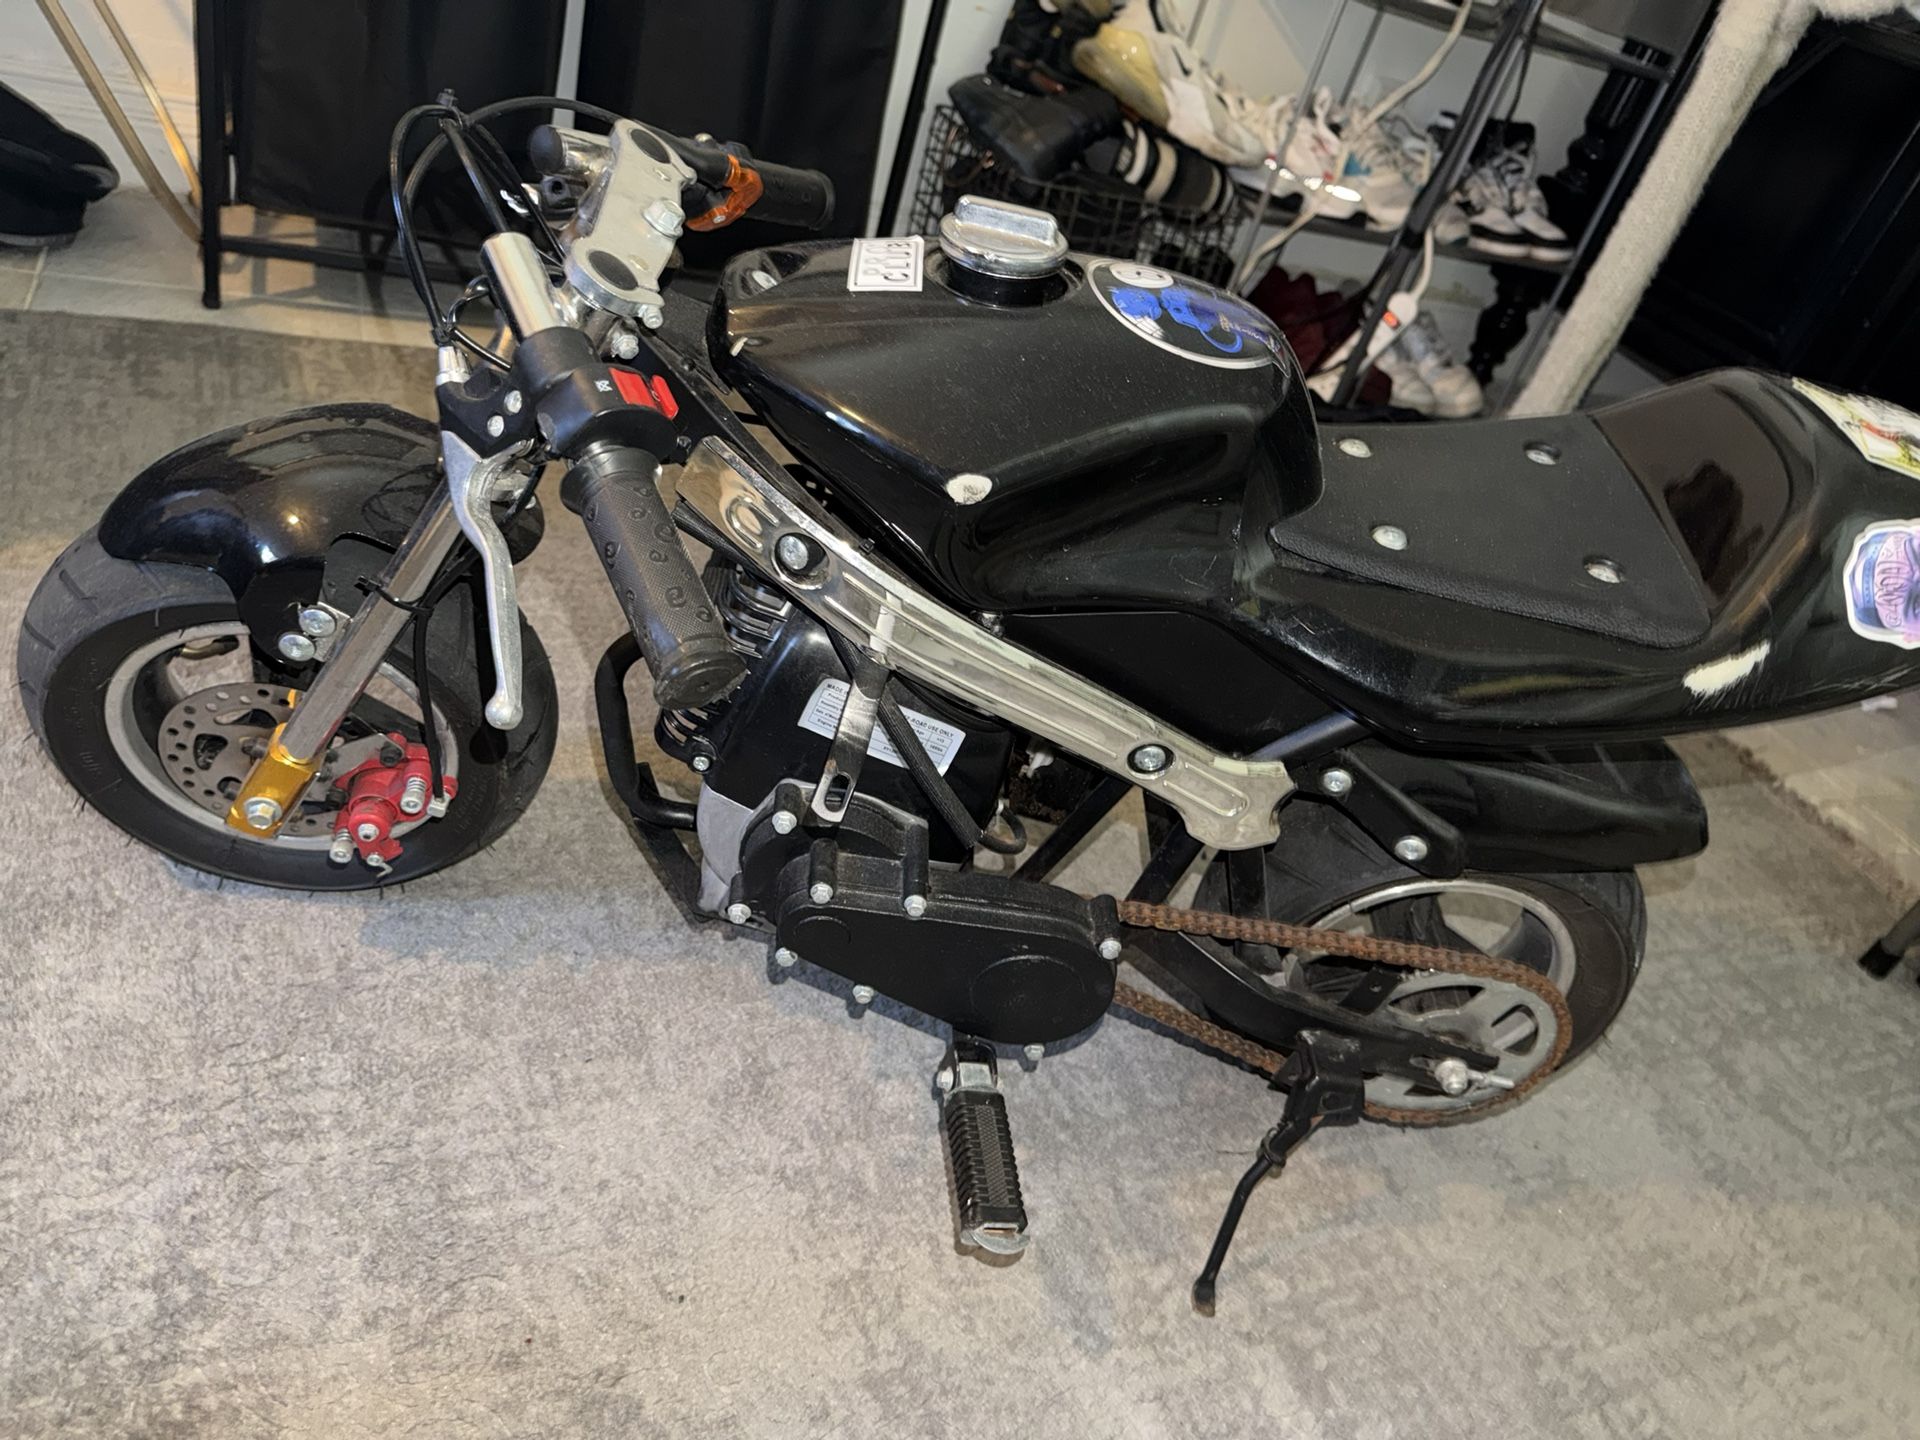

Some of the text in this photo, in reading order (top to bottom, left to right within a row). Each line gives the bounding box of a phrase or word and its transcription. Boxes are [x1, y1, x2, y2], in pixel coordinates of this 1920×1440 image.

[883, 242, 911, 283] CLUB
[827, 683, 844, 693] MADE
[927, 724, 938, 732] USE
[939, 728, 954, 738] ONLY
